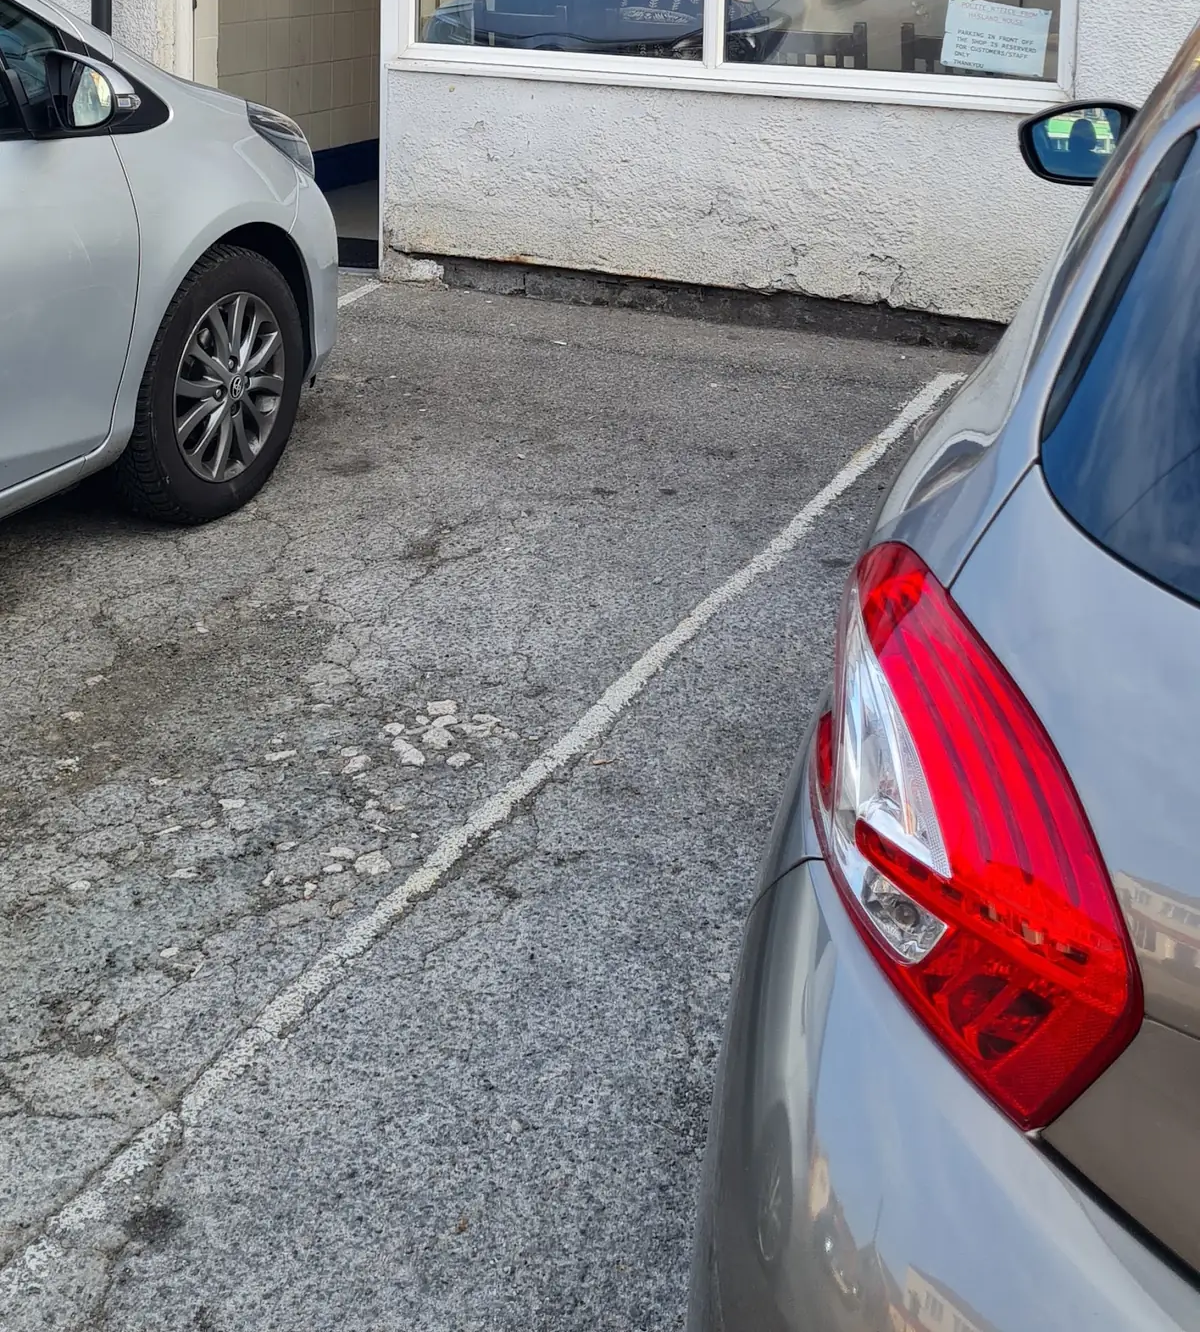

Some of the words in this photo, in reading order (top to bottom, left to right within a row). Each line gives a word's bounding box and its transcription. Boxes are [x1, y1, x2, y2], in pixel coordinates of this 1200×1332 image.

[957, 29, 984, 38] PARKING
[999, 35, 1019, 44] FRONT
[957, 36, 969, 44] THE
[954, 50, 970, 58] ONLY
